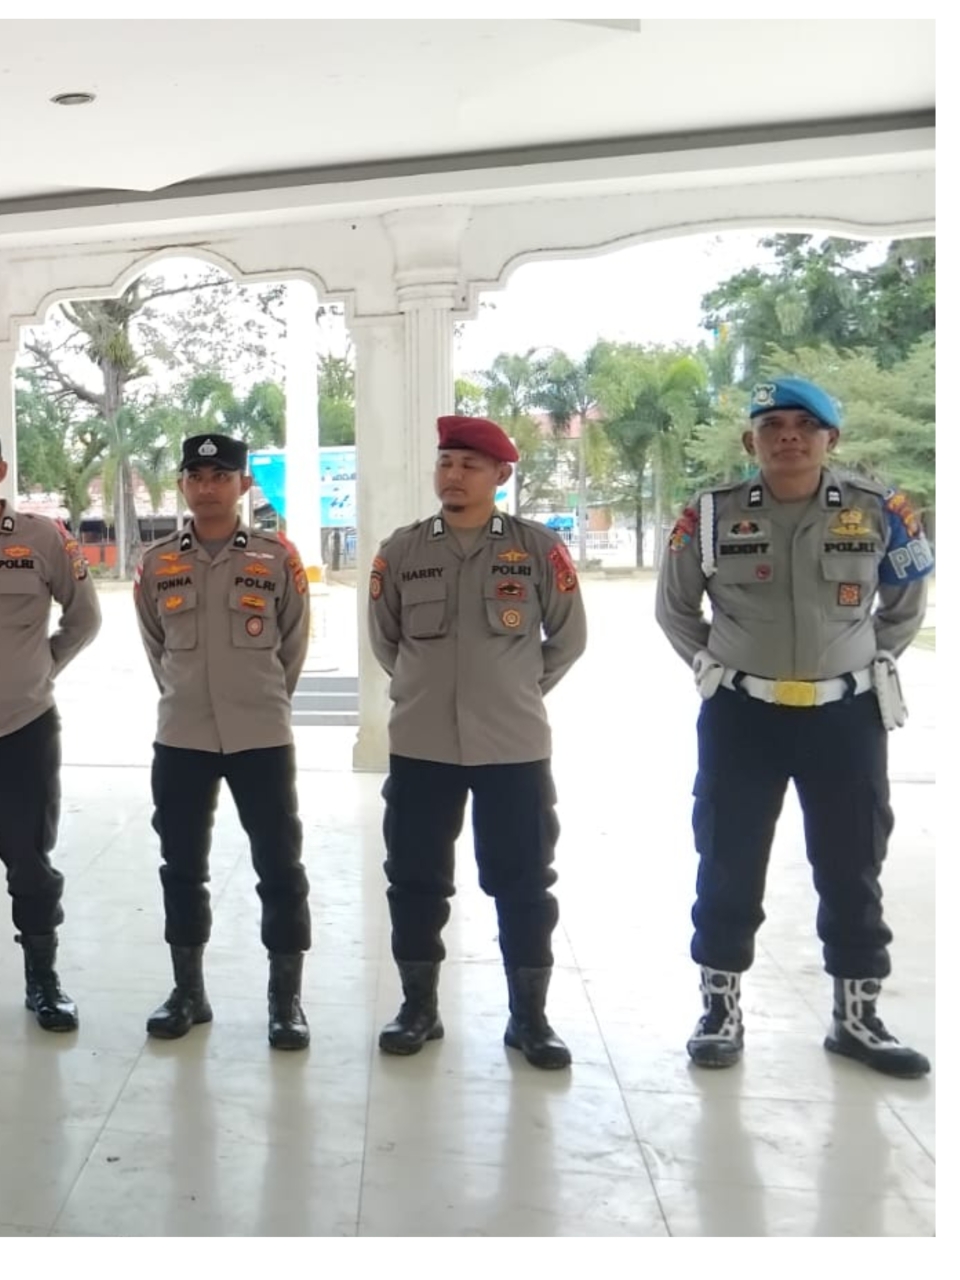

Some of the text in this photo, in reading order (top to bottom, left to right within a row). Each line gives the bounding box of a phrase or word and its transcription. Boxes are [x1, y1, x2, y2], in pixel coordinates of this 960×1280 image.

[824, 542, 876, 554] POLRI
[401, 565, 532, 582] HARRY POLRI
[234, 577, 277, 592] POLRI
